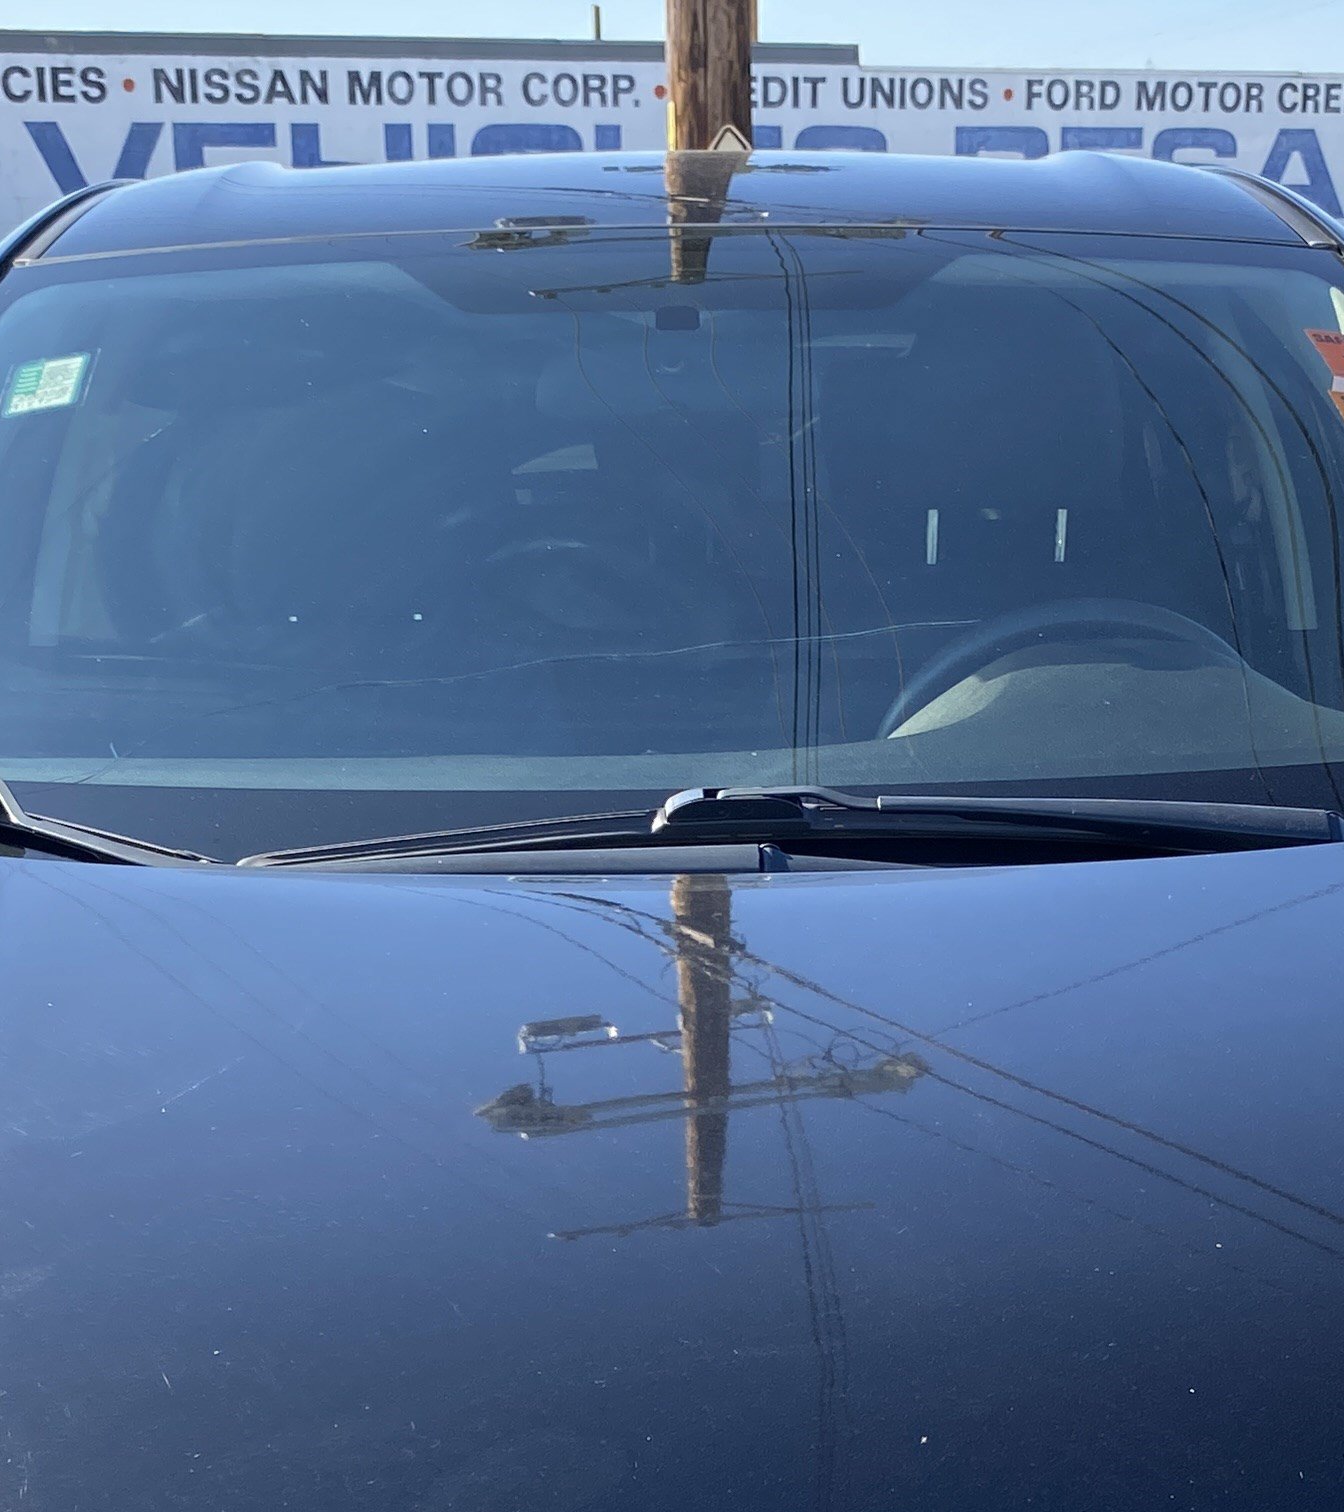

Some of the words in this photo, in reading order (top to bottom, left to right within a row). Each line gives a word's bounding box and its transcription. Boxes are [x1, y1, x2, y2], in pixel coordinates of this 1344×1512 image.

[152, 66, 330, 106] NISSAN
[346, 69, 503, 107] MOTOR
[521, 72, 640, 109] CORP.
[842, 76, 990, 111] UNIONS
[1025, 79, 1121, 112] FORD
[1137, 81, 1265, 114] MOTOR
